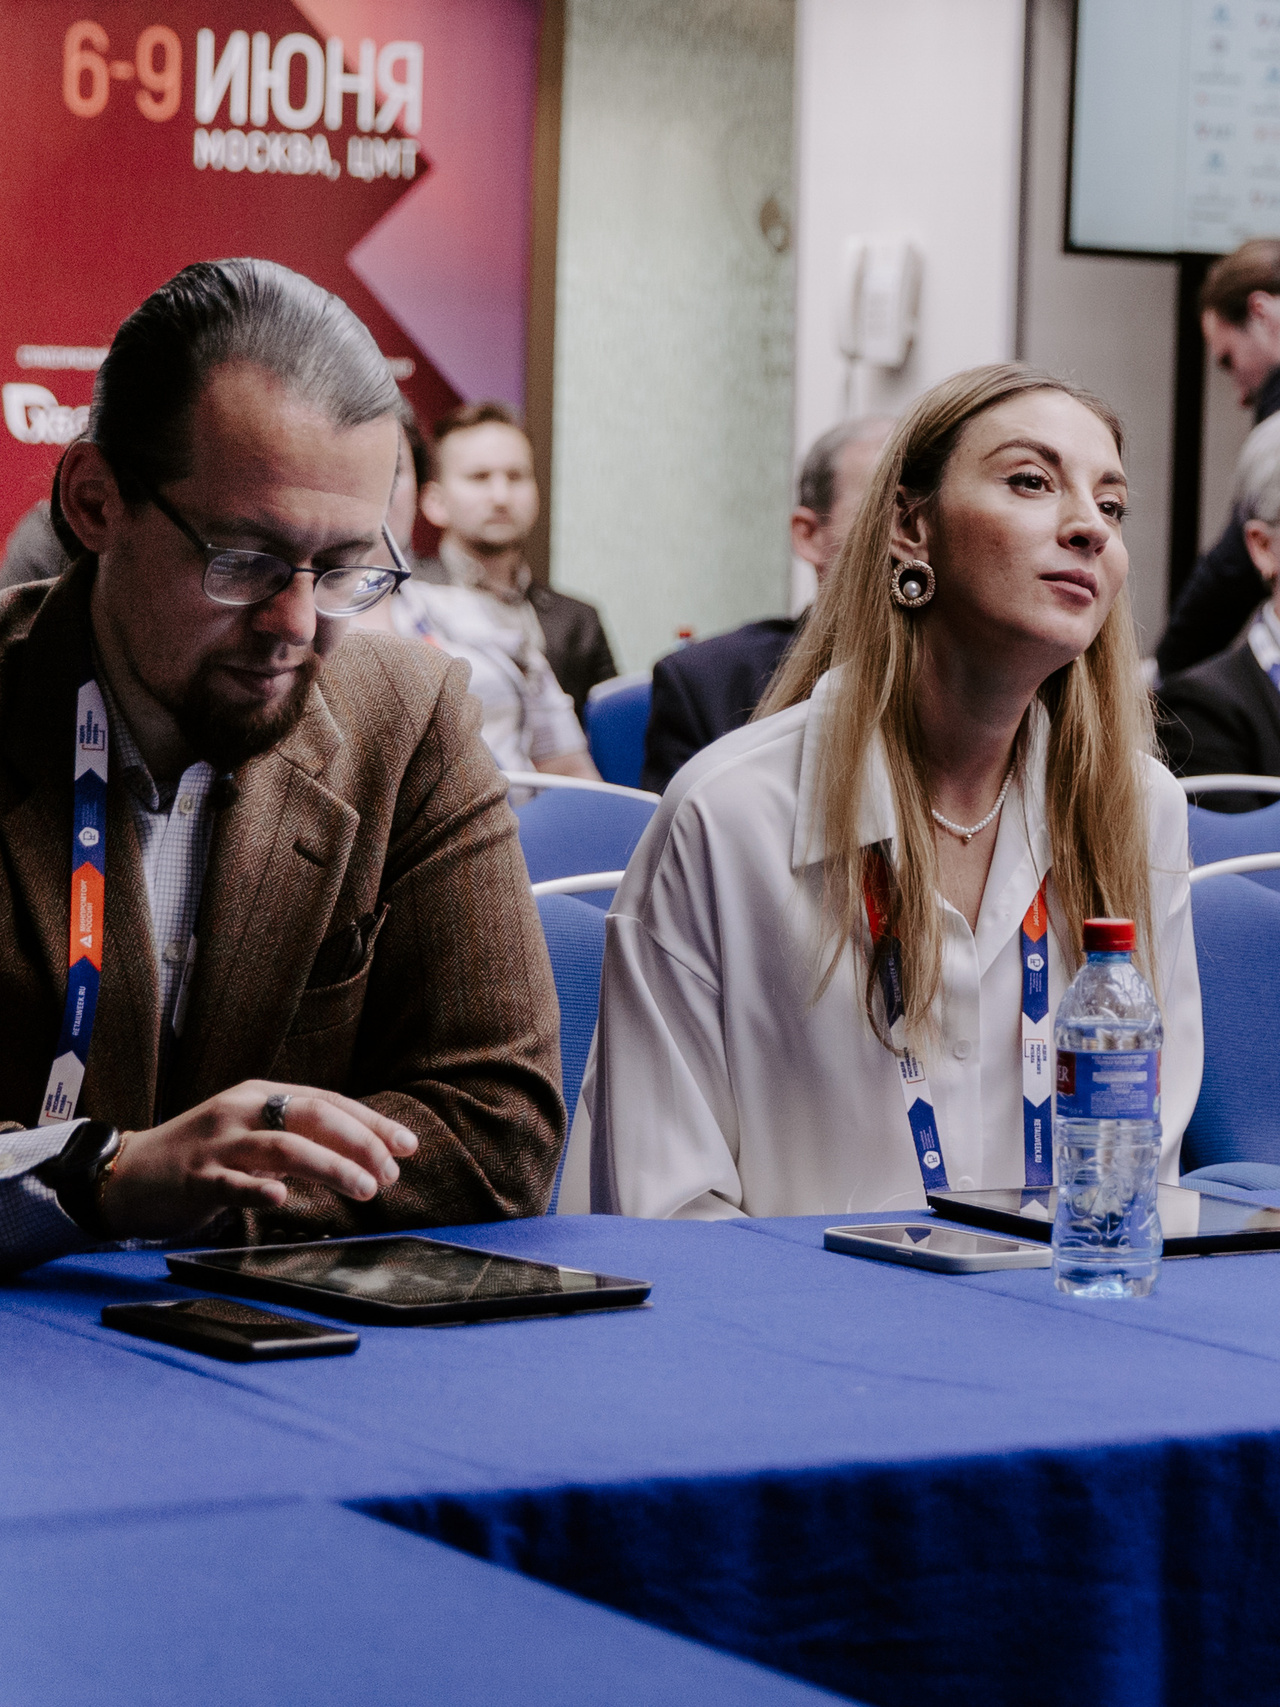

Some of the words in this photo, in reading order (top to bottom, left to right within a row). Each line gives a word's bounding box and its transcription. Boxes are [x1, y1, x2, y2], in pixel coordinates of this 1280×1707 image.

[63, 20, 183, 123] 6-9
[195, 28, 424, 135] ИЮНЯ
[193, 128, 341, 181] МОСКВА,
[72, 986, 86, 1036] RETAILWEEK.RU
[1034, 1119, 1042, 1163] RETAILWEEK.RU
